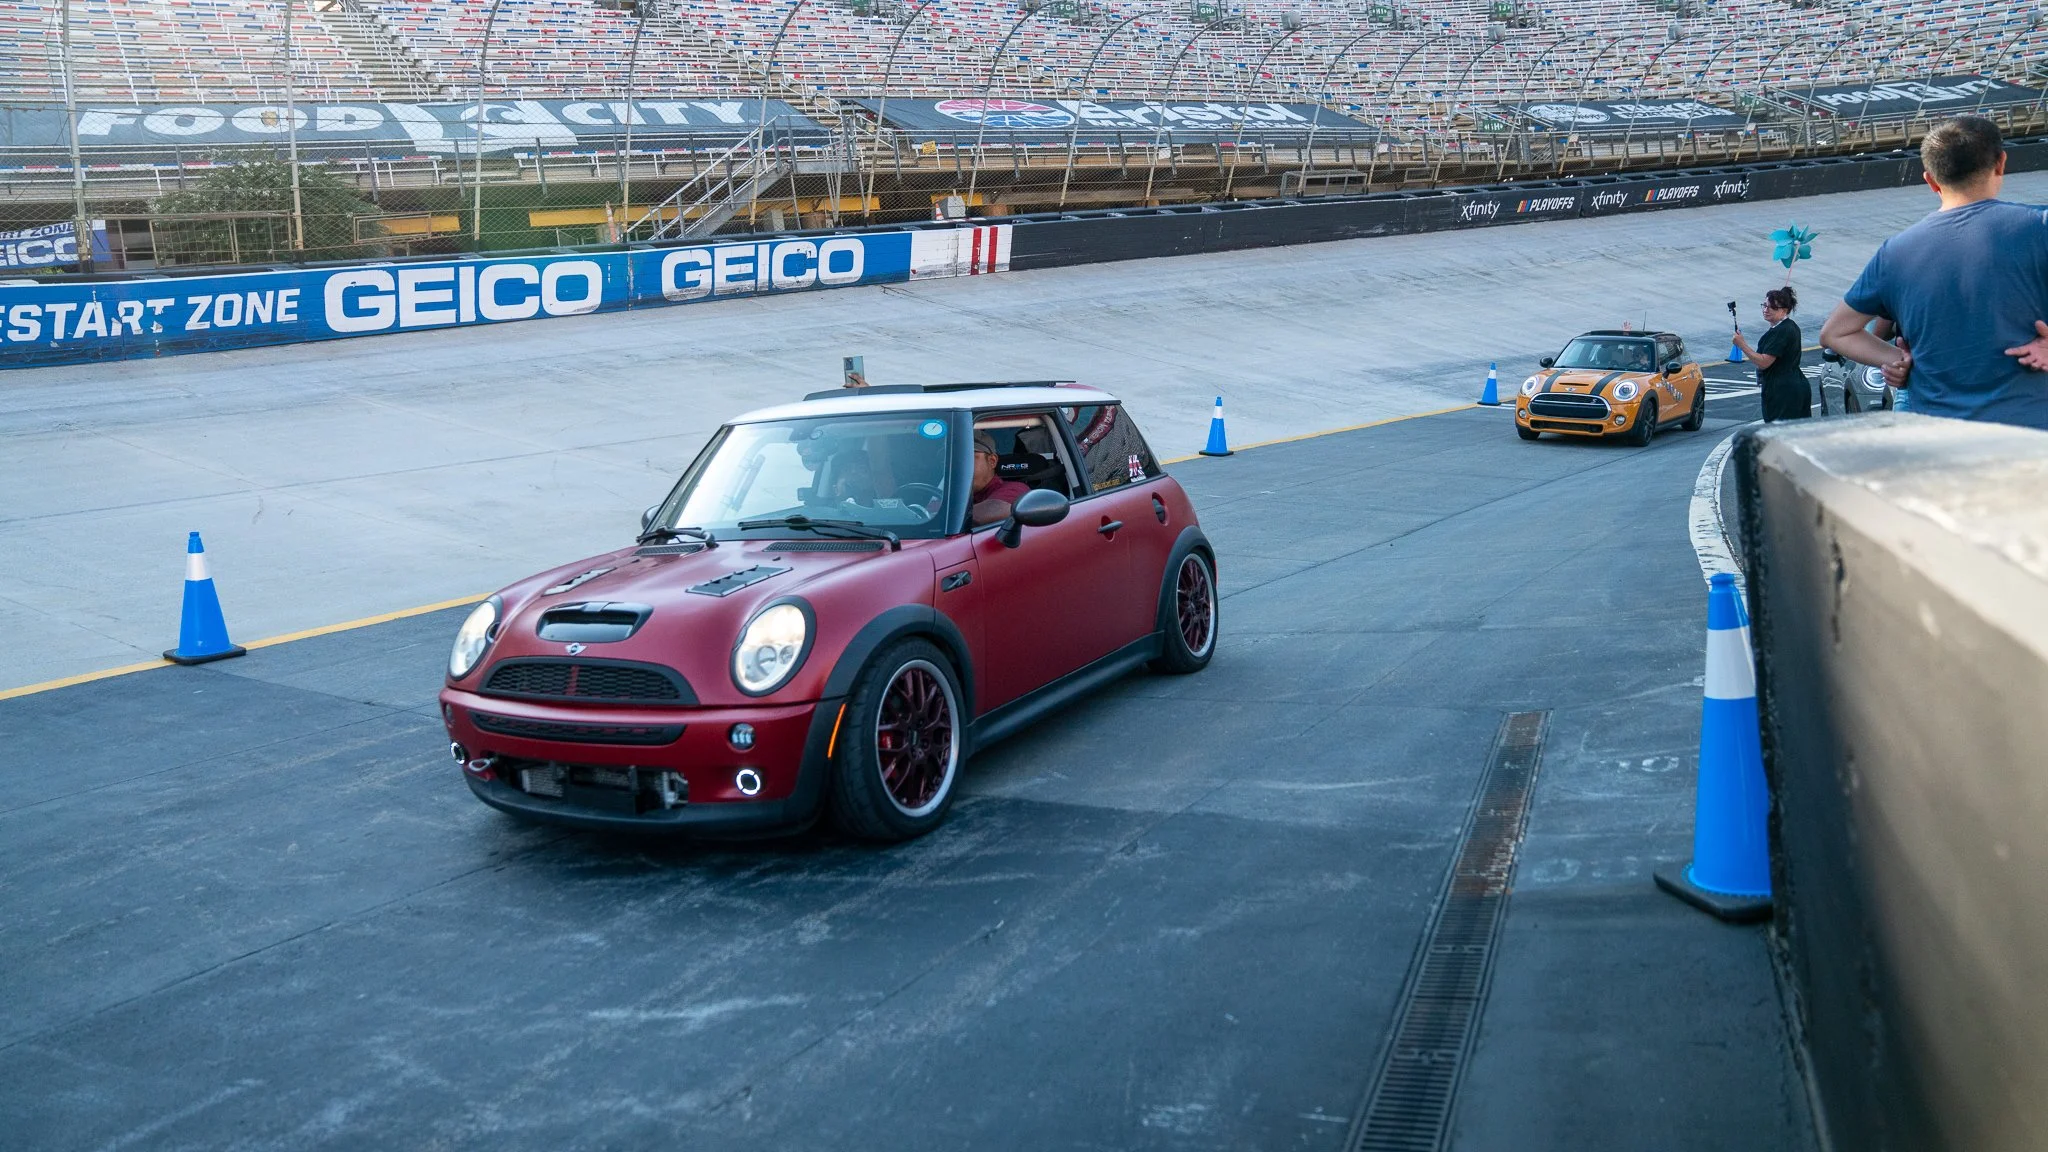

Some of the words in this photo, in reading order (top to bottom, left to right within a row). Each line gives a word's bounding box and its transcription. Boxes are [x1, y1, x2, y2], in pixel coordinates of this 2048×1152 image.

[1816, 90, 1900, 106] FOOD
[77, 105, 385, 136] FOOD
[561, 101, 747, 126] CITY
[1057, 99, 1308, 124] Bristol
[1656, 185, 1700, 201] PLAYOFFS
[1713, 179, 1750, 199] xfinity
[1461, 200, 1501, 220] xfinity
[1529, 196, 1575, 212] PLAYOFFS
[1590, 190, 1628, 210] xfinity
[661, 238, 864, 301] GEICO
[323, 260, 602, 333] GEICO
[185, 288, 300, 330] ZONE
